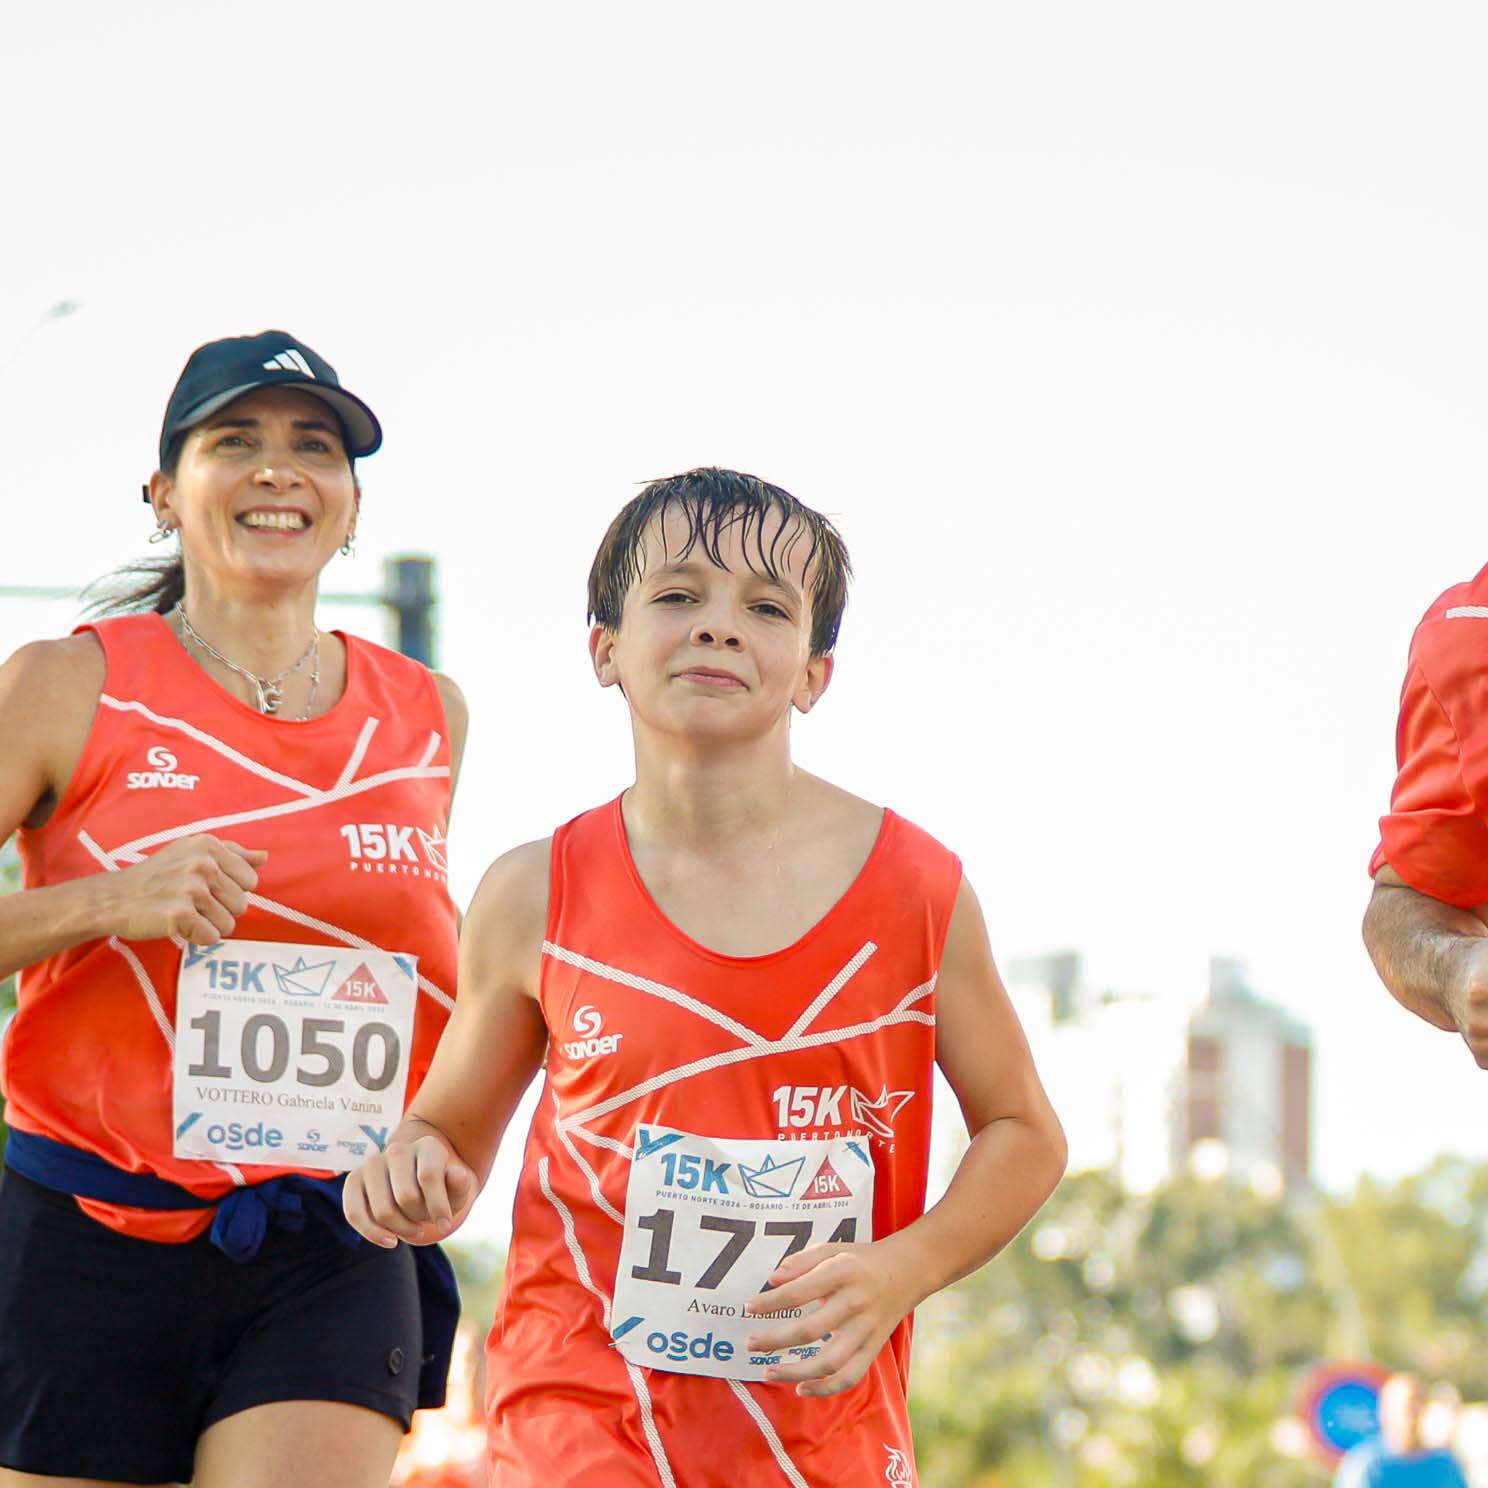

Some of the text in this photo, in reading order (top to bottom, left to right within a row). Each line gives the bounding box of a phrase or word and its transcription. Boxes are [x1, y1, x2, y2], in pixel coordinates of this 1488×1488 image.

[339, 823, 419, 862] 15K
[350, 861, 420, 876] PUERTO
[205, 959, 266, 993] 15K
[345, 981, 376, 998] 15K
[188, 1010, 401, 1092] 1050
[195, 1086, 382, 1114] VOTTERO Gabriela Vanina
[772, 1085, 848, 1128] 15K
[661, 1153, 731, 1194] 15K
[814, 1174, 841, 1194] 15K
[656, 1190, 688, 1201] PUERTO
[691, 1195, 717, 1205] NORTE
[749, 1202, 784, 1210] ROSARIO
[802, 1202, 811, 1210] DE
[813, 1201, 832, 1210] ABRIL
[687, 1299, 736, 1319] Avaro
